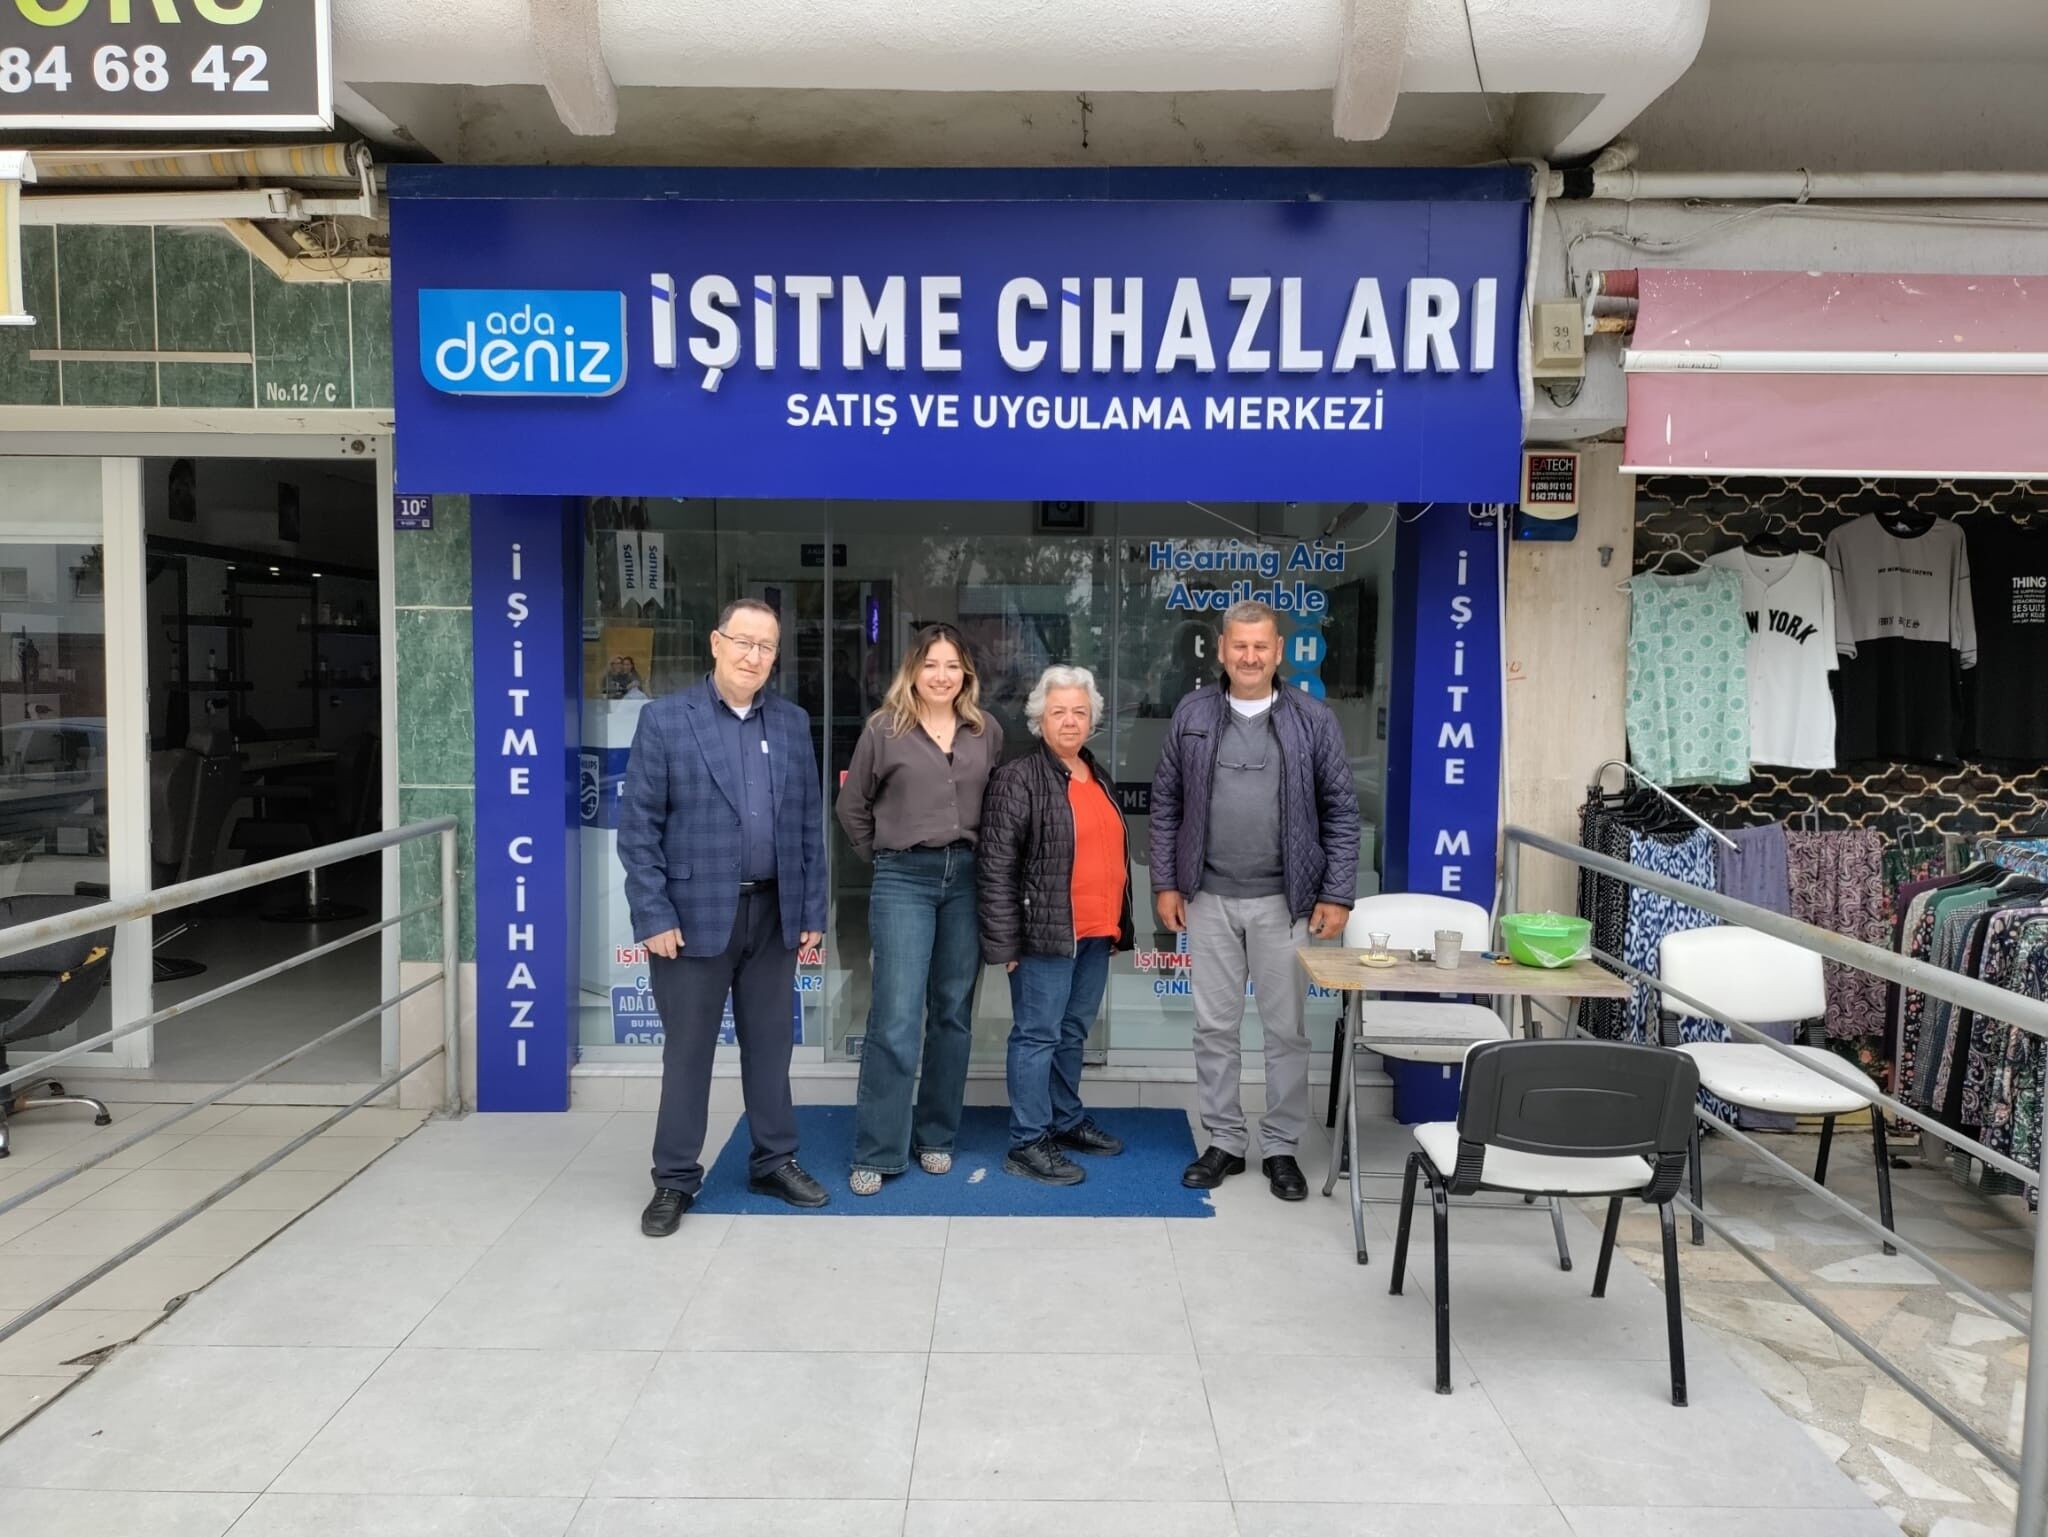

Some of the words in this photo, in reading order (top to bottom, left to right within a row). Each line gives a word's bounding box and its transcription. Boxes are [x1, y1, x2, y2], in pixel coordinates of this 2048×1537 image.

[93, 45, 169, 92] 68
[191, 45, 270, 92] 42
[485, 304, 555, 336] ada
[997, 276, 1498, 373] CİHAZLARI
[1553, 326, 1570, 338] 39
[435, 321, 611, 383] deniz
[325, 382, 337, 402] C
[786, 393, 898, 435] SATIŞ
[909, 395, 960, 429] VE
[973, 394, 1192, 430] UYGULAMA
[1204, 388, 1384, 430] MERKEZİ
[623, 543, 635, 589] PHILIPS
[648, 544, 658, 590] PHILIPS
[1150, 539, 1280, 578] Hearing
[1287, 541, 1345, 572] Aid
[1768, 608, 1818, 645] YORK
[506, 836, 537, 1066] CİHAZI
[616, 944, 649, 968] İŞİT
[619, 996, 645, 1011] ADA
